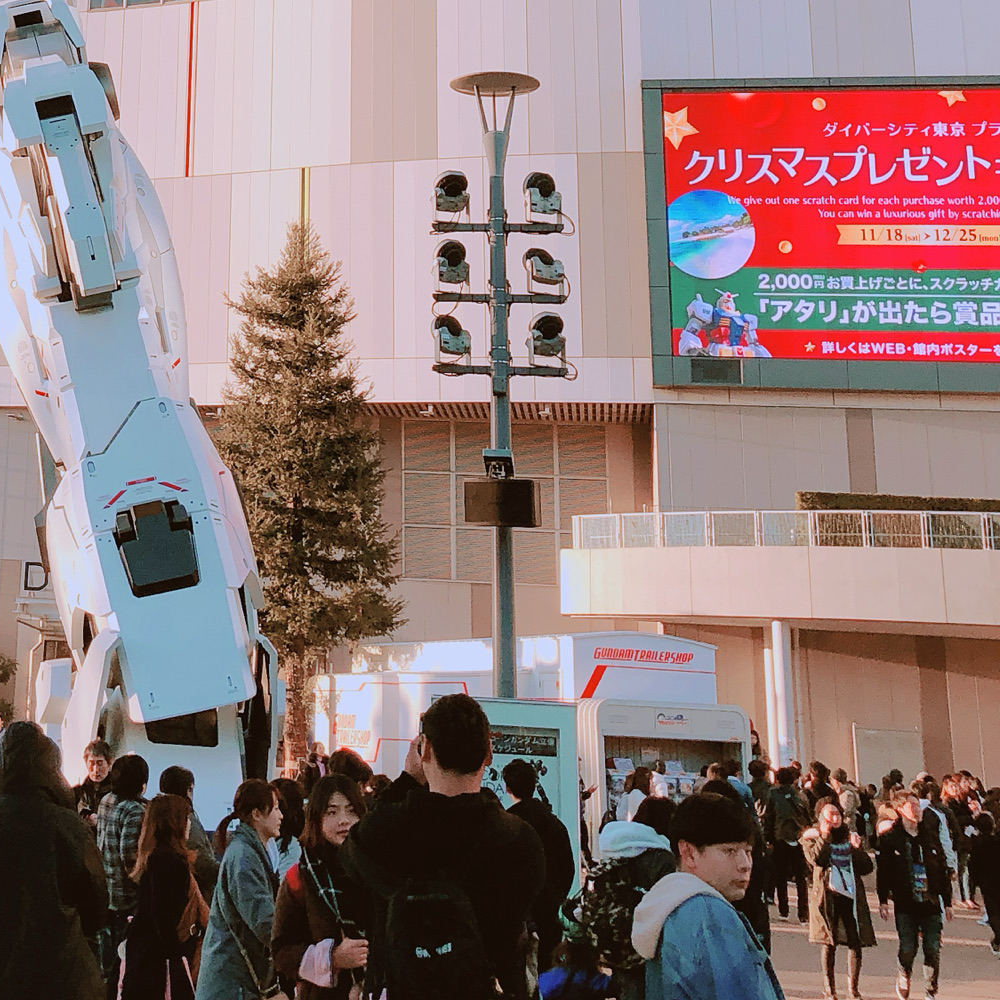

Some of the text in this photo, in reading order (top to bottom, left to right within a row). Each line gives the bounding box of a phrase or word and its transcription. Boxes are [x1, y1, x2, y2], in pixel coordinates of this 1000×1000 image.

[684, 145, 1000, 187] クリスマスプレゼント
[743, 195, 763, 207] give
[764, 195, 780, 205] out
[782, 197, 800, 205] one
[802, 195, 836, 205] scratch
[838, 195, 859, 205] card
[861, 195, 876, 205] for
[878, 195, 900, 206] each
[902, 195, 945, 208] purchase
[946, 195, 975, 206] worth
[977, 195, 1000, 206] 2,00
[818, 208, 1000, 221] You can win a luxurious gift by scratchi
